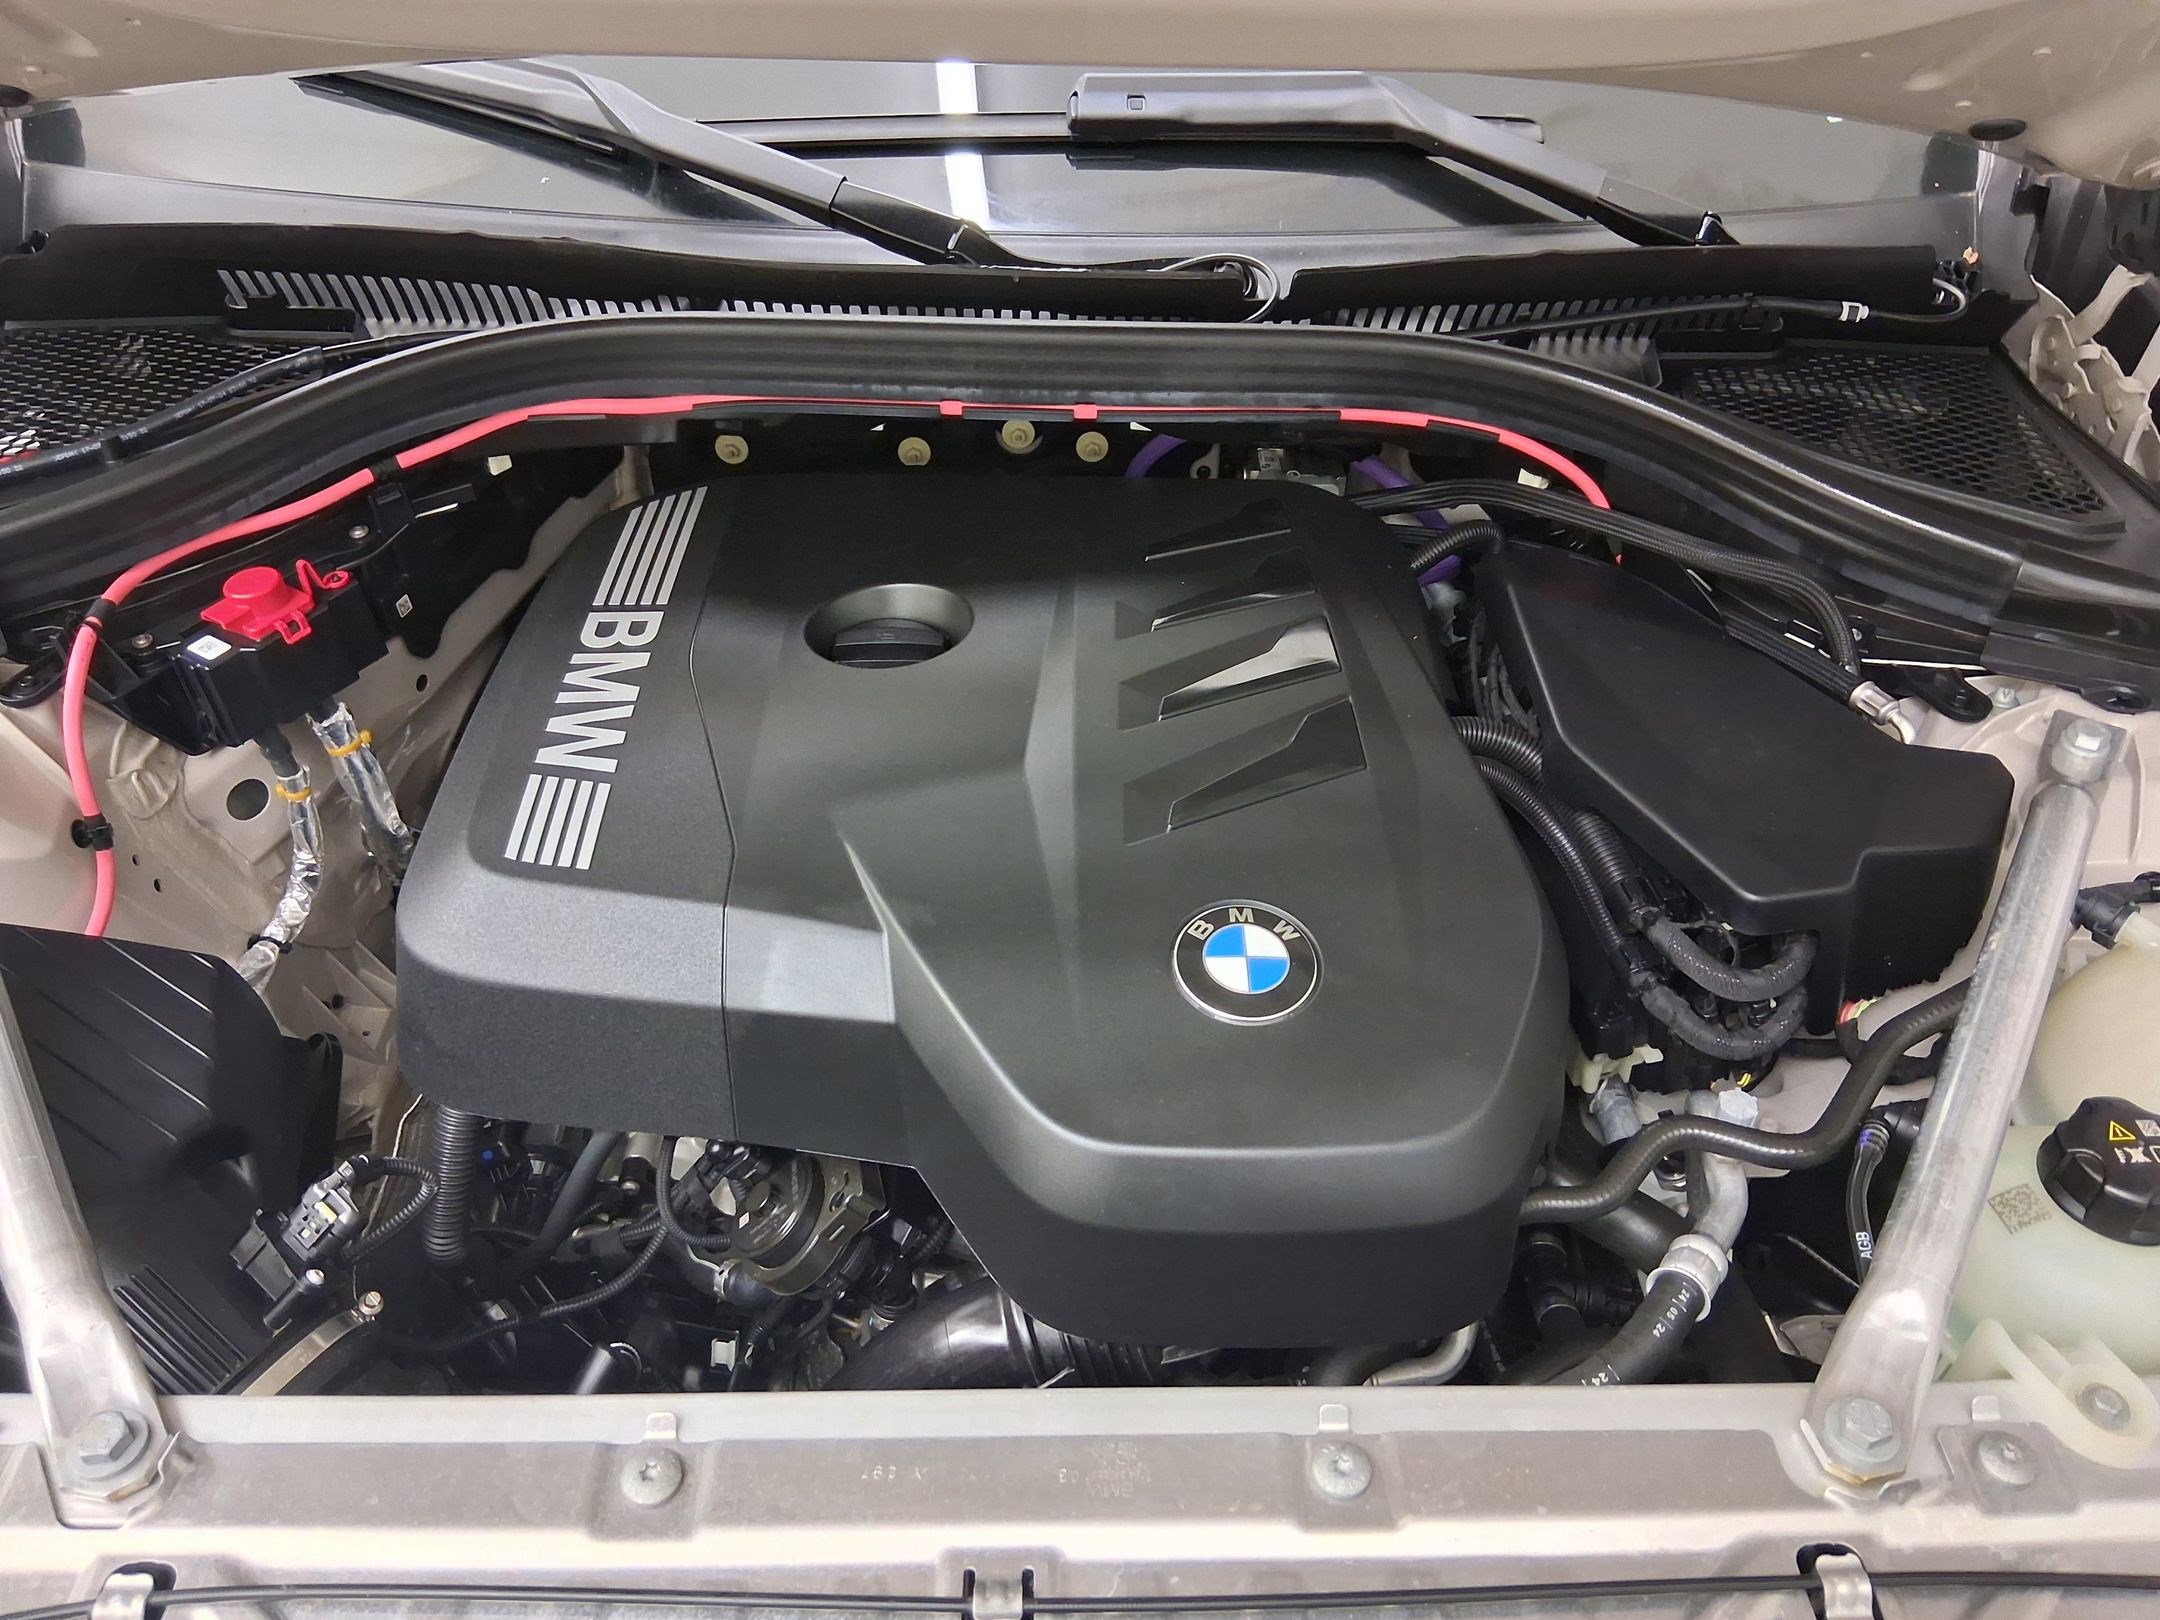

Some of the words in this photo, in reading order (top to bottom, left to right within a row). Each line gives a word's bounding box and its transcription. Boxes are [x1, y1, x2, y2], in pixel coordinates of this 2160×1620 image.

[534, 610, 665, 773] BMW
[1187, 907, 1301, 941] BMW
[1855, 1231, 1873, 1260] AGB
